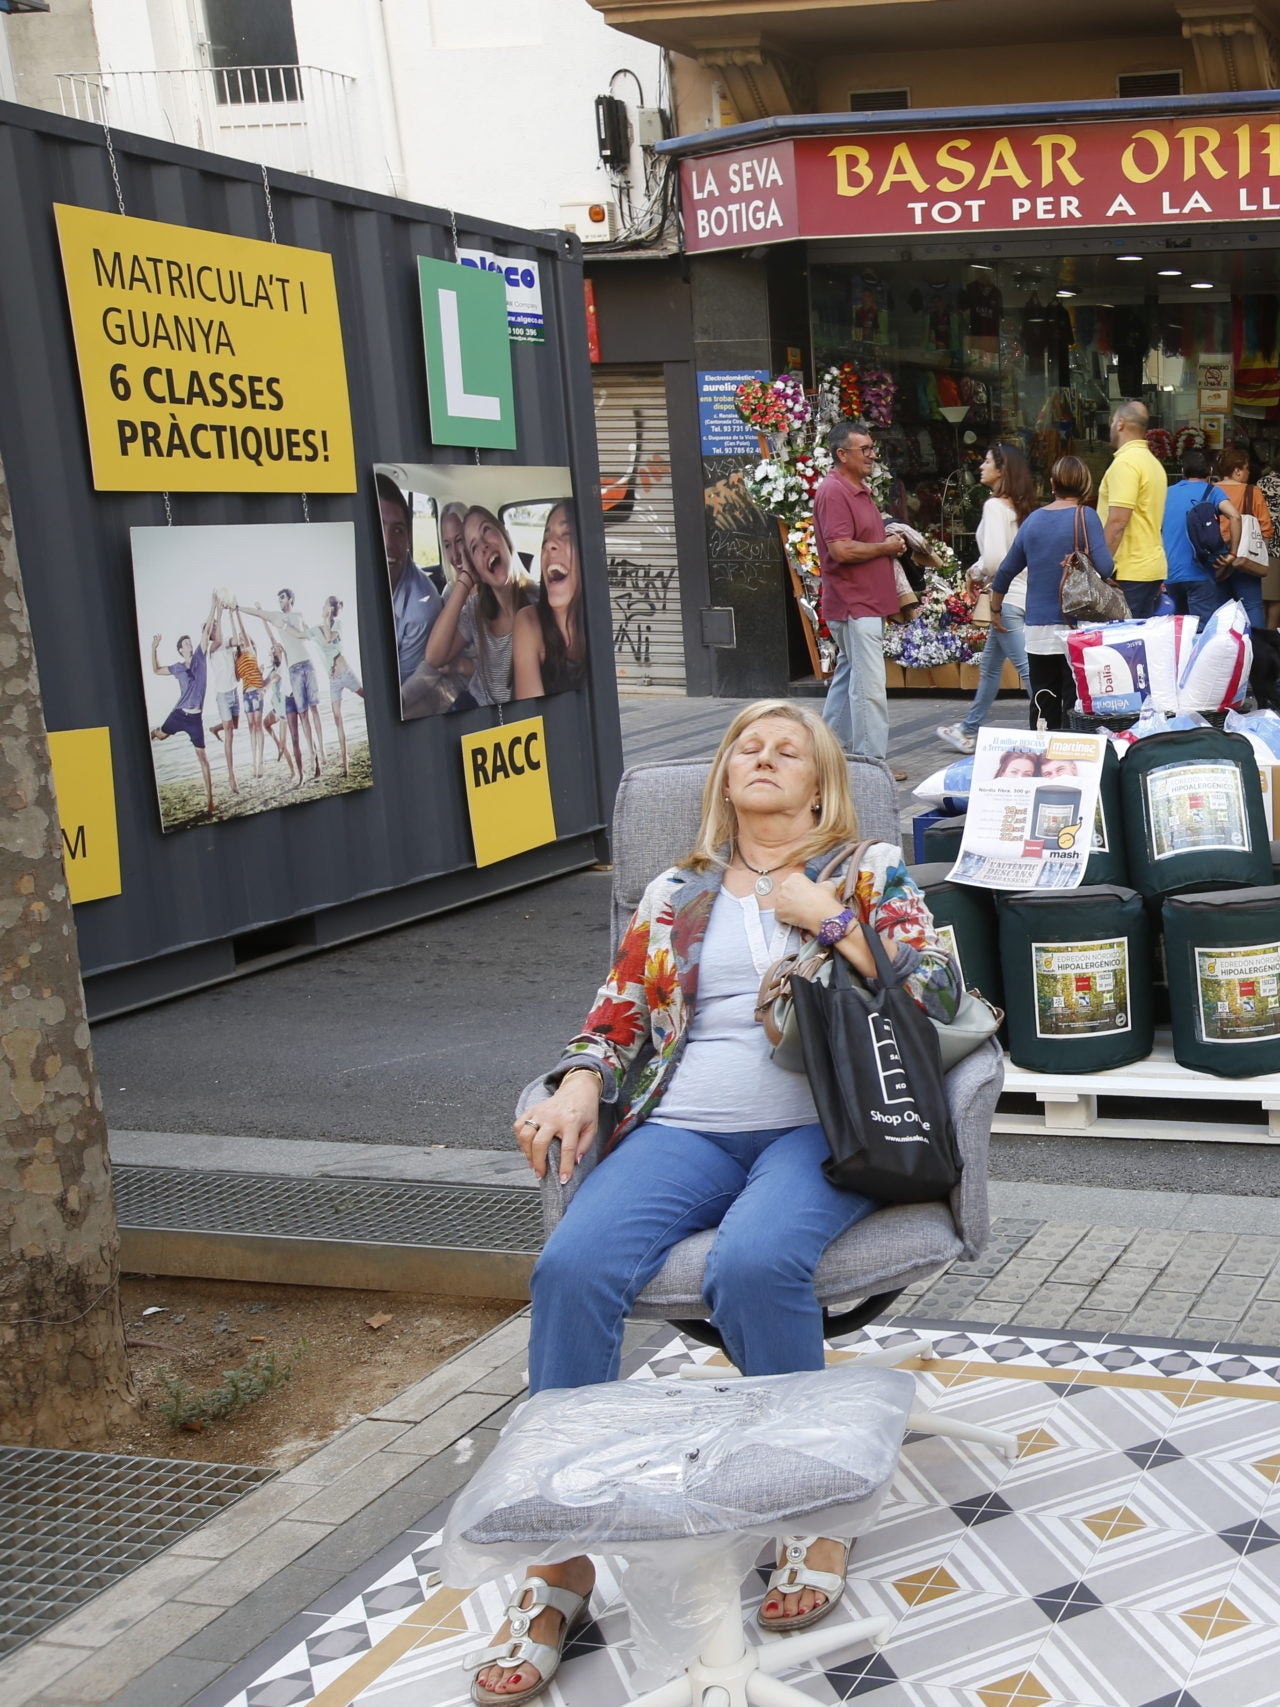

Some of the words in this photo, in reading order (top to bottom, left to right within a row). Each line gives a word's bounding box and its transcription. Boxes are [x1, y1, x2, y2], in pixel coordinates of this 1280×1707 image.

[691, 169, 718, 200] LA
[728, 157, 784, 192] SEVA
[827, 134, 1084, 196] BASAR
[697, 198, 784, 239] BOTIGA
[907, 199, 986, 225] TOT
[1012, 195, 1083, 221] PER
[1106, 193, 1136, 217] A
[1162, 190, 1213, 214] LA
[300, 282, 308, 314] I
[102, 306, 235, 356] GUANYA
[438, 288, 501, 421] L
[109, 364, 131, 400] 6
[143, 366, 284, 411] CLASSES
[703, 383, 736, 391] aurelio
[116, 414, 331, 466] PRÀCTIQUES!
[1103, 665, 1113, 693] Dalia
[1097, 700, 1129, 710] Velfont
[470, 732, 541, 787] RACC
[1049, 851, 1079, 859] mash
[1057, 959, 1120, 970] HIPOALERGÉNICO
[870, 1110, 901, 1126] Shop
